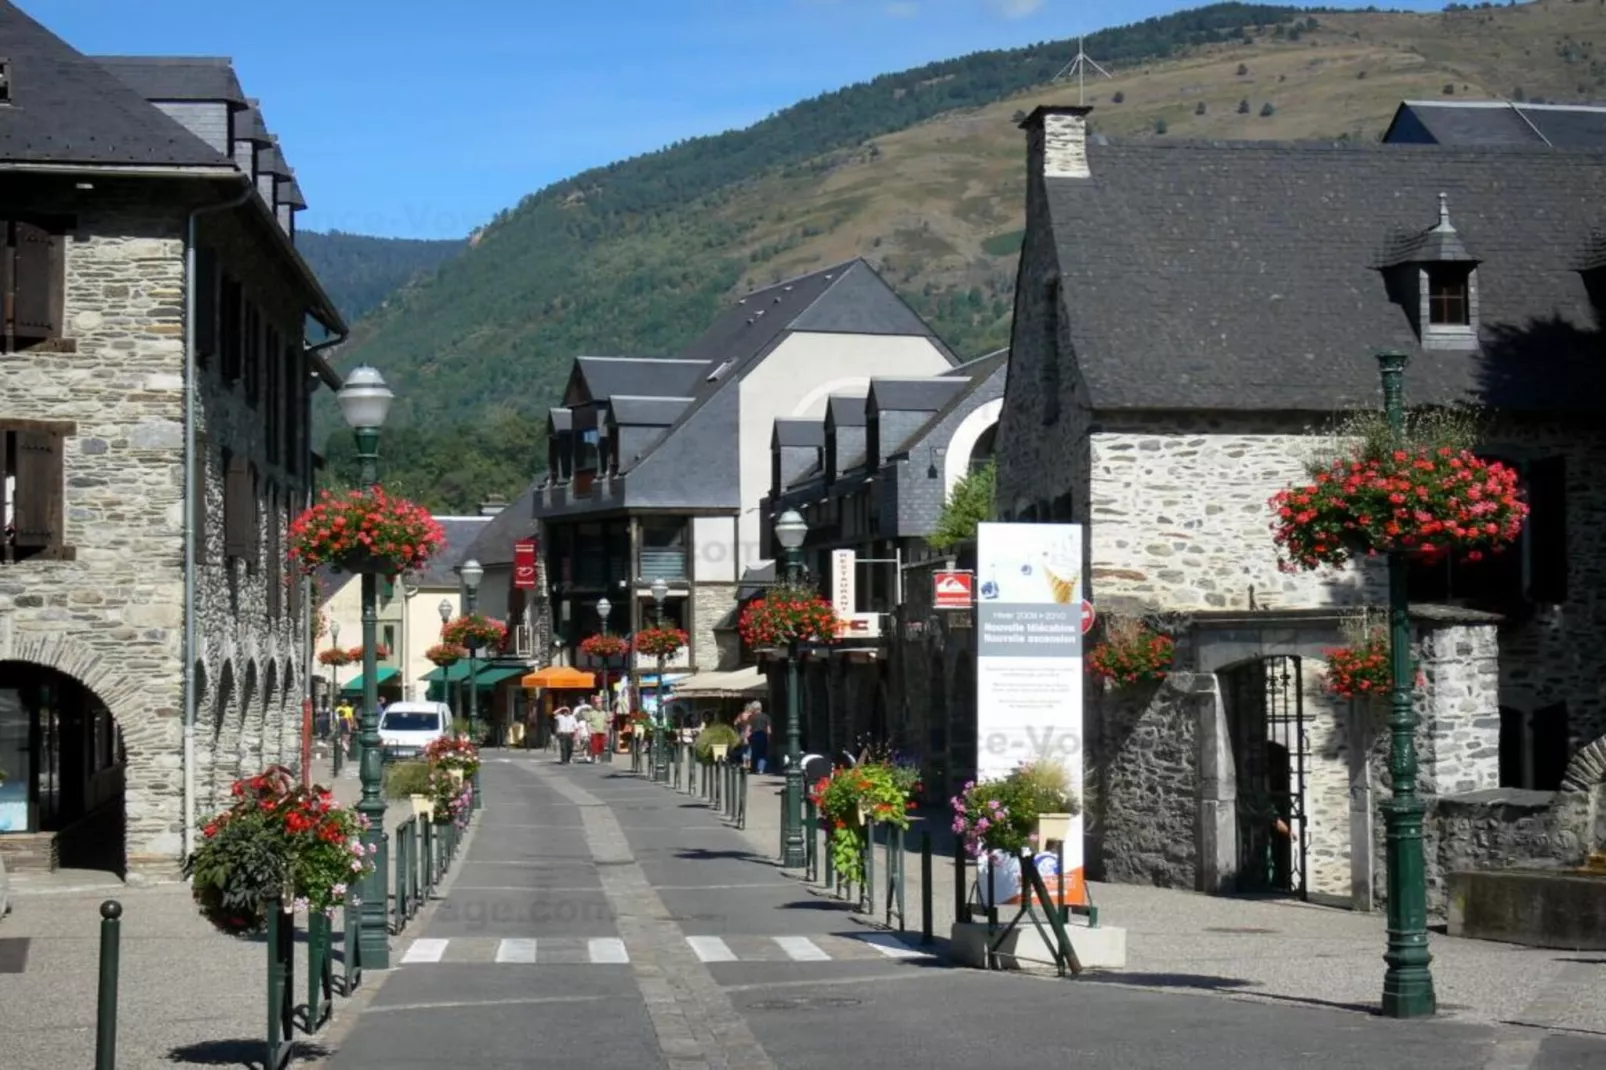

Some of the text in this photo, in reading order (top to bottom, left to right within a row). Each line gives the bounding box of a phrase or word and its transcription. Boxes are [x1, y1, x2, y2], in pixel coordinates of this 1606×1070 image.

[839, 552, 849, 612] RESTAURANT
[984, 622, 1025, 633] Nouvelle
[984, 633, 1025, 644] Nouvelle
